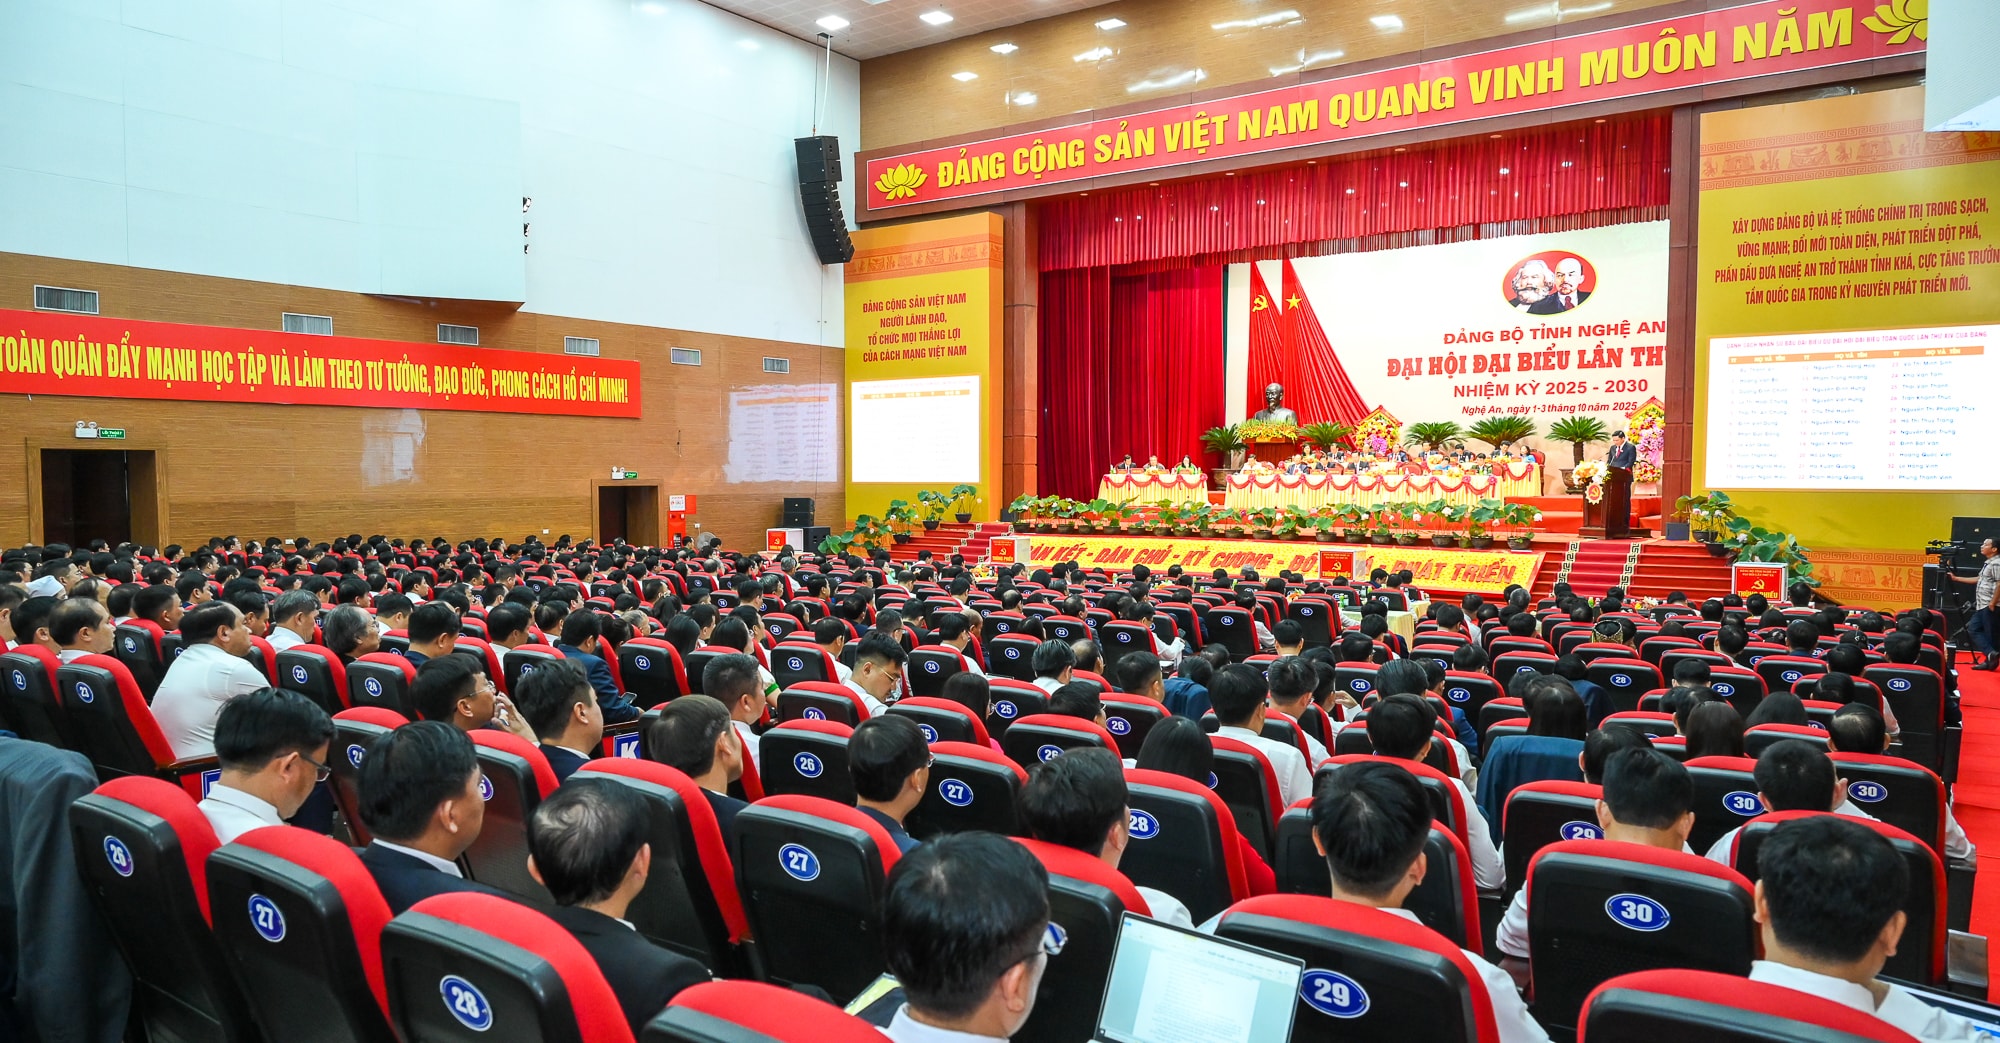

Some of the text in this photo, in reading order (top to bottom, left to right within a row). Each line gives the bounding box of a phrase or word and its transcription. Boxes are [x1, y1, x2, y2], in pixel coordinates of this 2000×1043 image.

[938, 8, 1853, 187] ĐẢNG CỘNG SẢN VIỆT NAM QUANG VINH MUÔN NĂM
[1732, 198, 1988, 235] XÂY DỰNG ĐẢNG BỘ VÀ HỆ THỐNG CHÍNH TRỊ TRONG SẠCH,
[1738, 222, 1981, 258] VỮNG MẠNH; ĐỔI MỚI TOÀN DIỆN, PHÁT TRIỂN ĐỘT PHÁ,
[1759, 264, 1776, 280] ĐƯA
[1779, 261, 1802, 280] NGHỆ
[1804, 263, 1816, 277] AN
[1819, 257, 1836, 276] TRỞ
[1838, 257, 1868, 274] THÀNH
[1870, 254, 1891, 272] TỈNH
[1894, 252, 1915, 270] KHÁ,
[1918, 252, 1937, 271] CỰC
[1940, 250, 1965, 267] TĂNG
[1766, 284, 1788, 304] QUỐC
[1792, 288, 1806, 302] GIA
[1808, 286, 1837, 300] TRONG
[1840, 280, 1851, 298] KỶ
[1854, 280, 1890, 298] NGUYÊN
[1893, 278, 1917, 295] PHÁT
[1920, 273, 1946, 293] TRIỂN
[1950, 274, 1970, 291] MỚI.
[863, 293, 966, 312] ĐẢNG CỘNG SẢN VIỆT NAM
[1444, 320, 1666, 344] ĐẢNG BỘ TỈNH NGHỆ AN
[52, 335, 102, 378] QUÂN
[108, 332, 140, 378] ĐẨY
[147, 347, 197, 388] MẠNH
[202, 350, 234, 390] HỌC
[238, 347, 266, 390] TẬP
[272, 350, 290, 386] VÀ
[294, 352, 325, 387] LÀM
[329, 359, 362, 389] THEO
[366, 360, 384, 390] TƯ
[386, 354, 432, 397] TƯỞNG,
[435, 366, 459, 400] ĐẠO
[462, 363, 489, 399] ĐỨC,
[492, 370, 530, 398] PHONG
[533, 368, 560, 399] CÁCH
[563, 367, 577, 400] HỒ
[580, 372, 596, 401] CHÍ
[600, 378, 628, 402] MINH!
[1388, 341, 1667, 380] ĐẠI HỘI ĐẠI BIỂU LẦN TH
[1454, 379, 1648, 400] NHIỆM KỲ 2025 2030
[1451, 558, 1516, 584] TRIỂN
[15, 675, 23, 685] 22
[1615, 676, 1626, 684] 28
[1786, 672, 1797, 680] 29
[1893, 680, 1905, 688] 30
[81, 687, 89, 698] 23
[369, 682, 378, 692] 24
[1355, 681, 1366, 690] 26
[1717, 685, 1729, 694] 29
[1453, 690, 1464, 699] 27
[809, 711, 820, 720] 24
[1001, 704, 1012, 714] 25
[1112, 721, 1125, 731] 26
[621, 741, 640, 758] K
[800, 757, 815, 771] 26
[947, 785, 964, 799] 27
[1858, 785, 1877, 797] 30
[1734, 797, 1754, 810] 30
[1129, 816, 1148, 832] 28
[1572, 827, 1595, 840] 29
[110, 844, 127, 867] 26
[789, 850, 809, 872] 27
[256, 904, 274, 930] 27
[1621, 900, 1652, 923] 30
[1314, 979, 1350, 1007] 29
[452, 988, 480, 1018] 28
